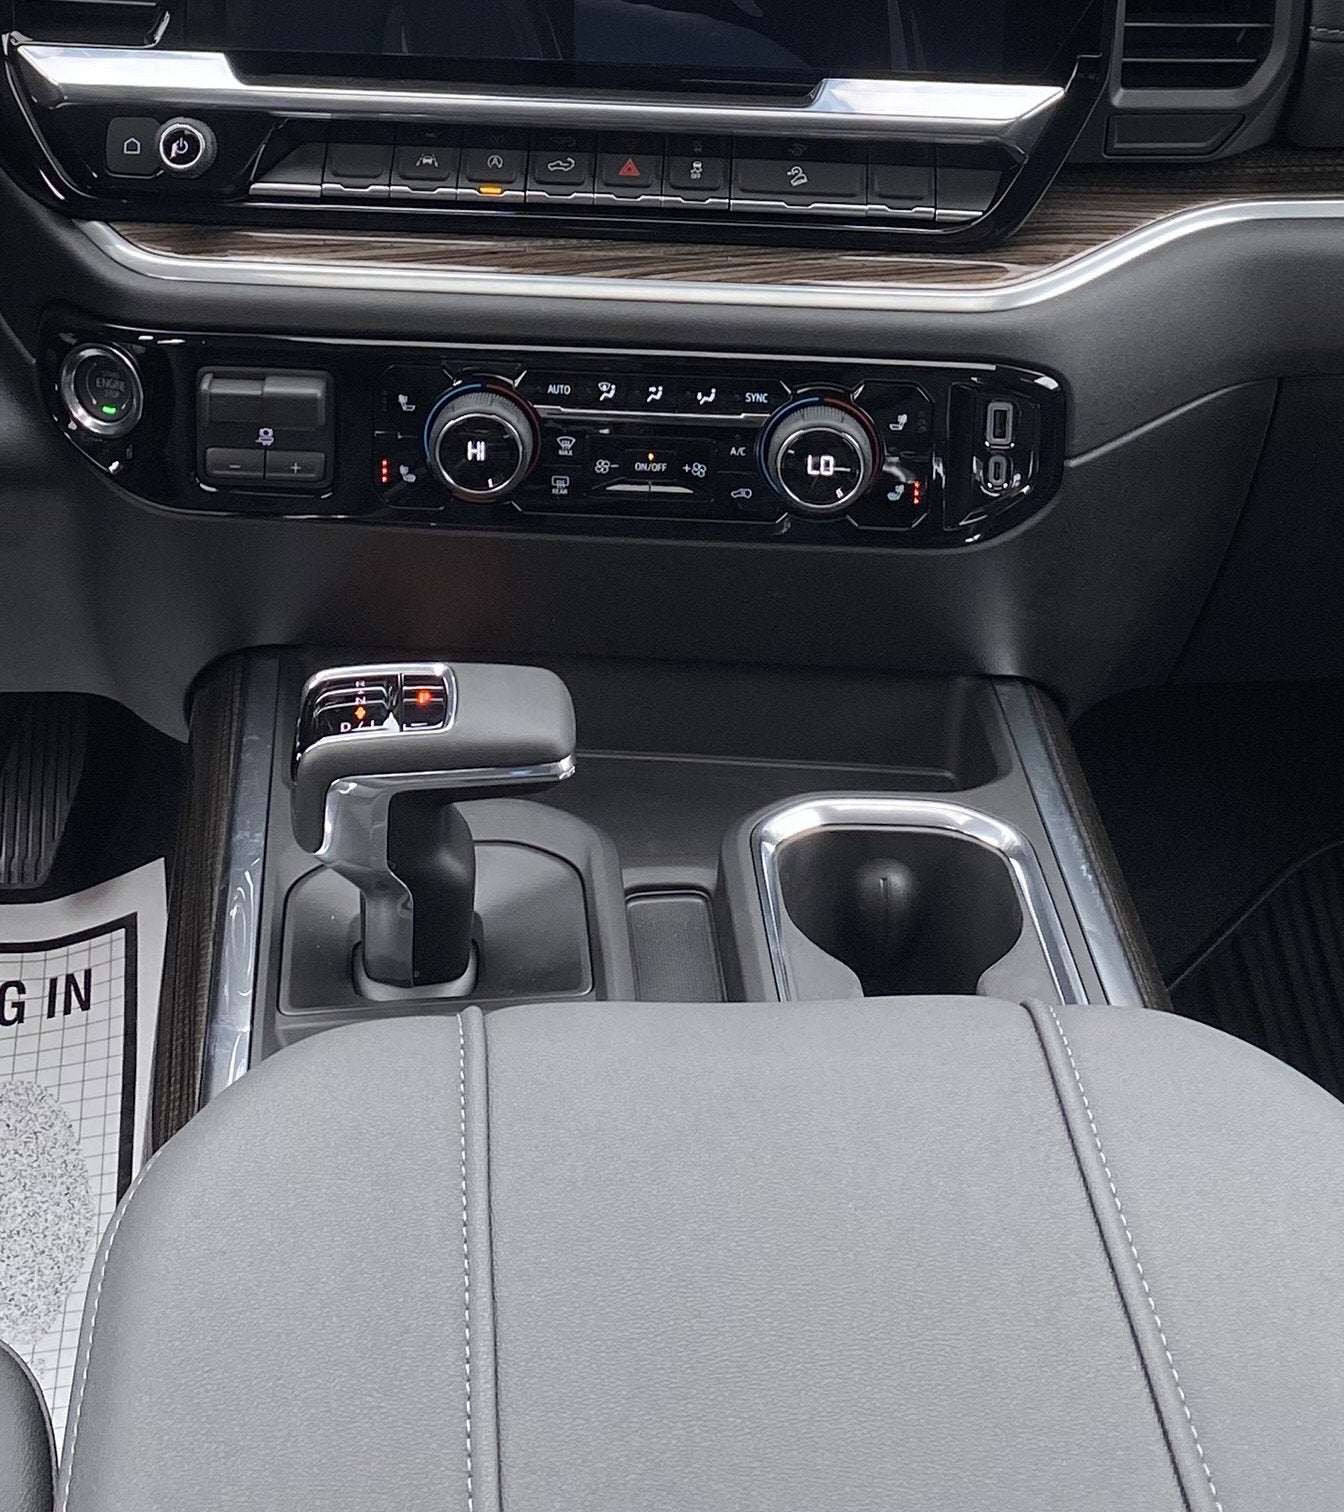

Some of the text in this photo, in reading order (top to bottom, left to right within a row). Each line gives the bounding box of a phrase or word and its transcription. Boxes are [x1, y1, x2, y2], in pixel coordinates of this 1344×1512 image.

[547, 384, 572, 395] AUTO
[745, 392, 768, 403] SYNC
[467, 440, 486, 461] HI
[730, 447, 747, 456] A/C
[634, 462, 667, 472] ON/OFF
[46, 968, 93, 1018] IN
